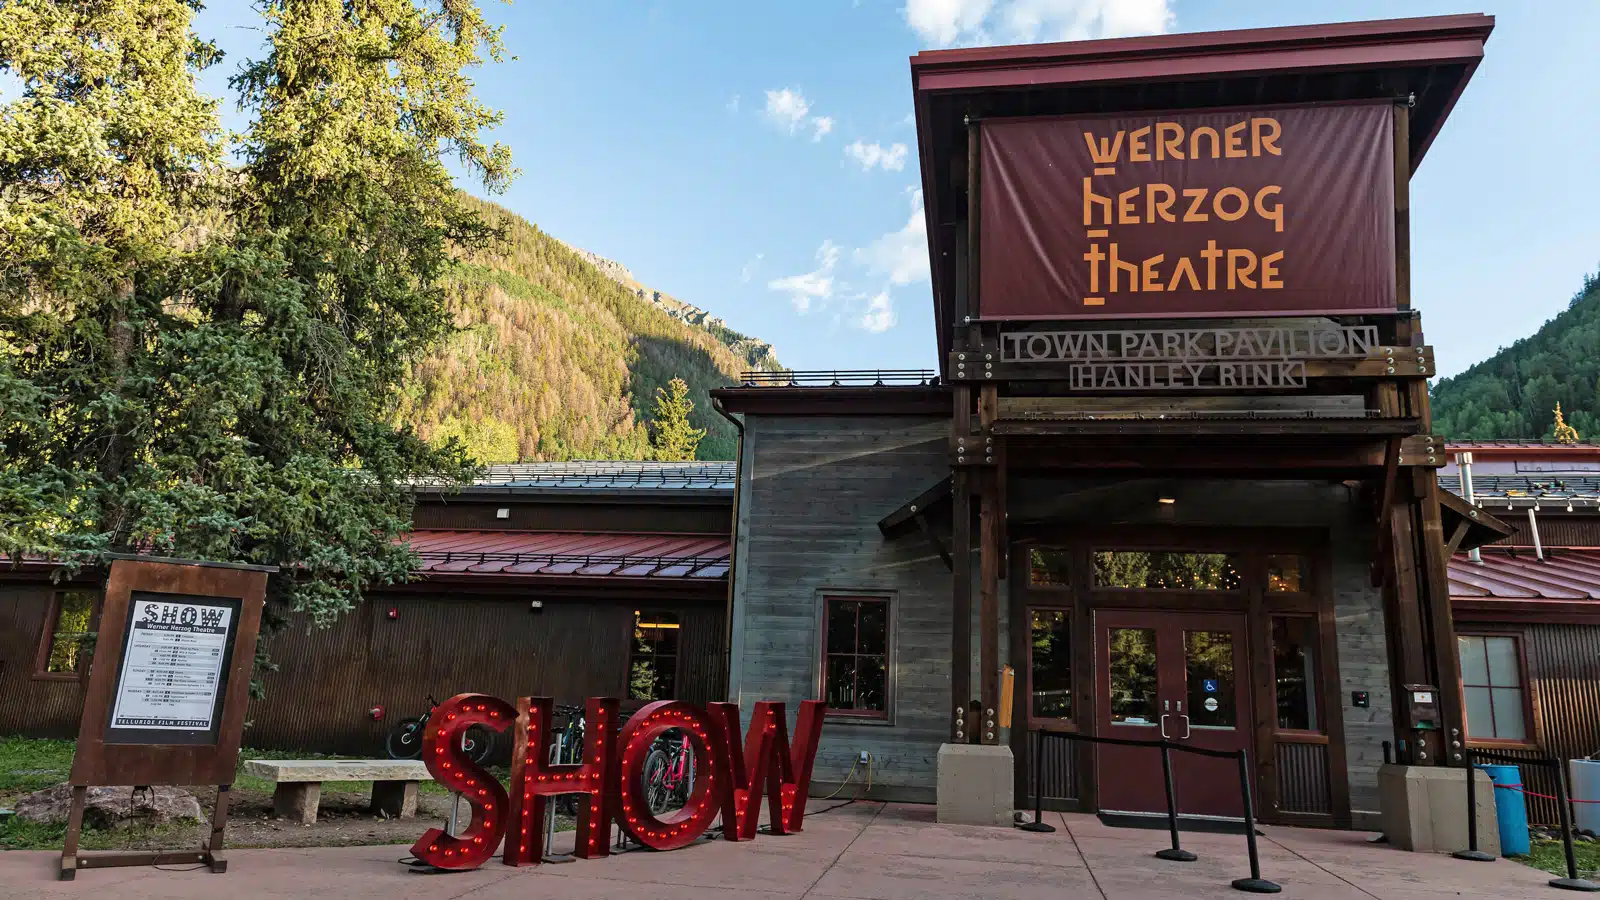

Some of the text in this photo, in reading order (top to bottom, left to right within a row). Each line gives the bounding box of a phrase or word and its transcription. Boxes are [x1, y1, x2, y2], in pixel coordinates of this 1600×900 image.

[1011, 326, 1374, 360] TOWN PARK PAVILION
[1077, 362, 1299, 388] HANLEY RINK
[141, 603, 225, 628] SHOW
[170, 624, 192, 633] Herzog
[193, 625, 216, 633] Theatre
[409, 692, 828, 870] SHOW
